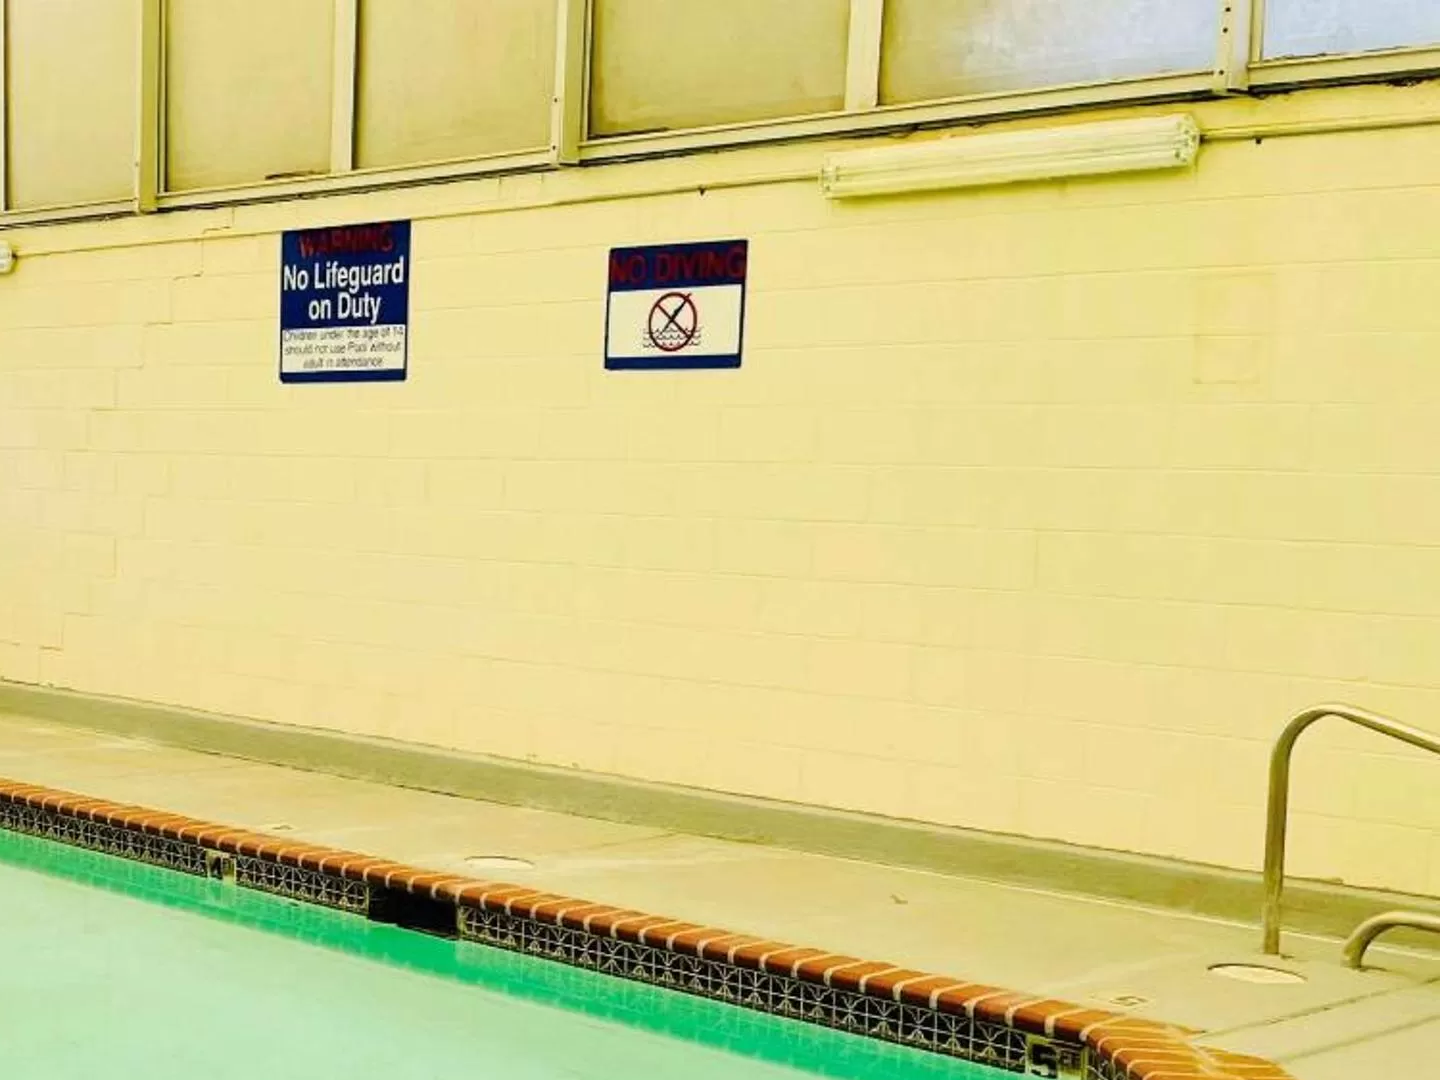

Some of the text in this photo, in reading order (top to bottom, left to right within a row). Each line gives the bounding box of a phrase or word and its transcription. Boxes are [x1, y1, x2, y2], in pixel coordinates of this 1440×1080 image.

[299, 223, 394, 257] WARNING
[283, 255, 405, 295] No Lifeguard
[611, 244, 746, 284] NO DIVING
[308, 292, 382, 325] on Duty
[283, 330, 318, 342] Children
[320, 329, 344, 340] under
[347, 328, 360, 339] the
[363, 328, 379, 341] age
[284, 344, 313, 356] should
[330, 344, 345, 354] use
[370, 341, 401, 353] without
